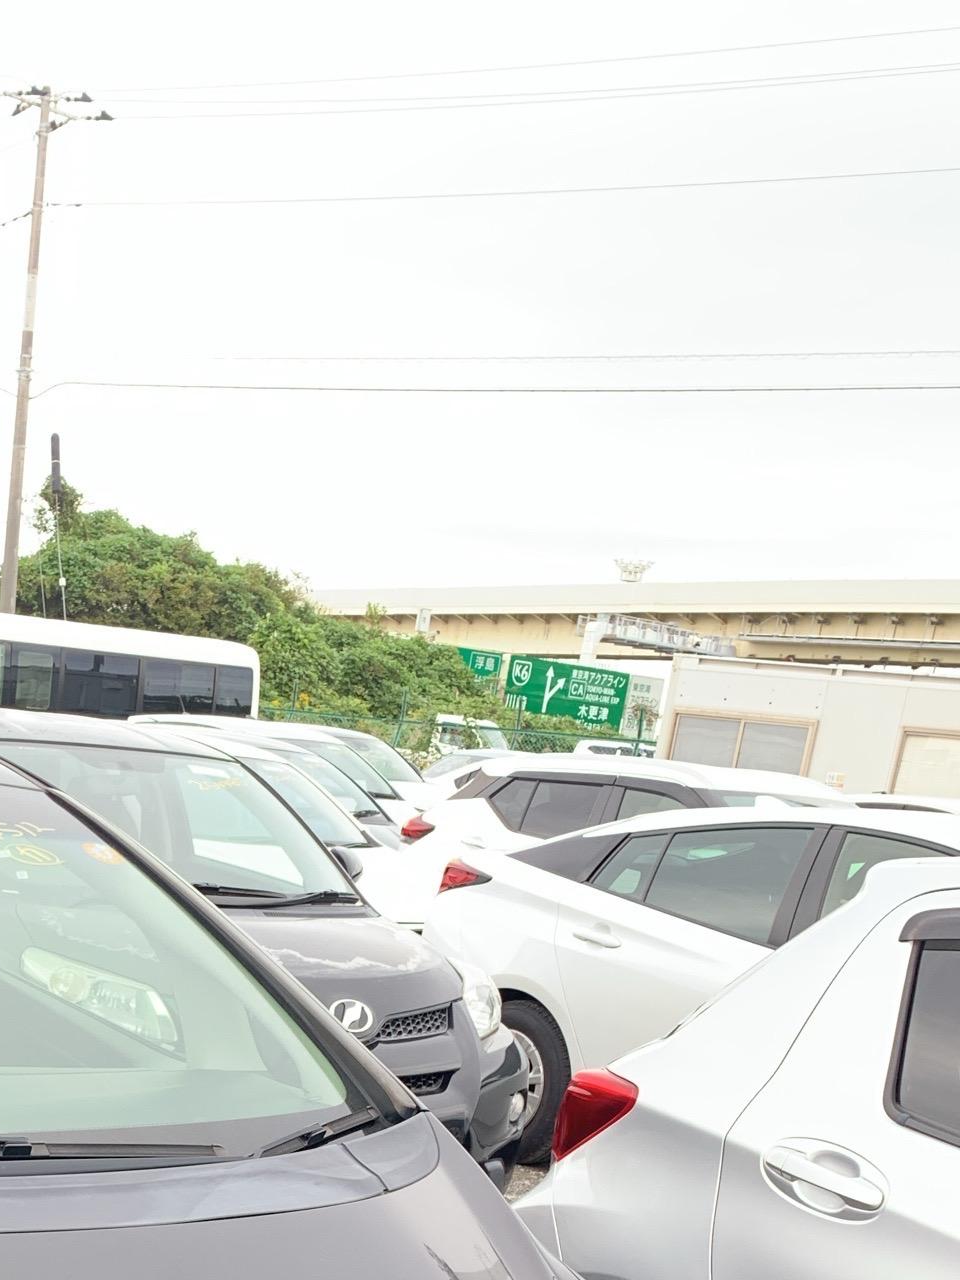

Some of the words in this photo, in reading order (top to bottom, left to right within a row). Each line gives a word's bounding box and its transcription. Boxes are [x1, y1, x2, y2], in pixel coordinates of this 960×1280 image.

[514, 663, 529, 681] K6
[572, 669, 627, 688] 東京湾アクアライン
[571, 683, 584, 697] CA
[577, 704, 609, 722] 木更津
